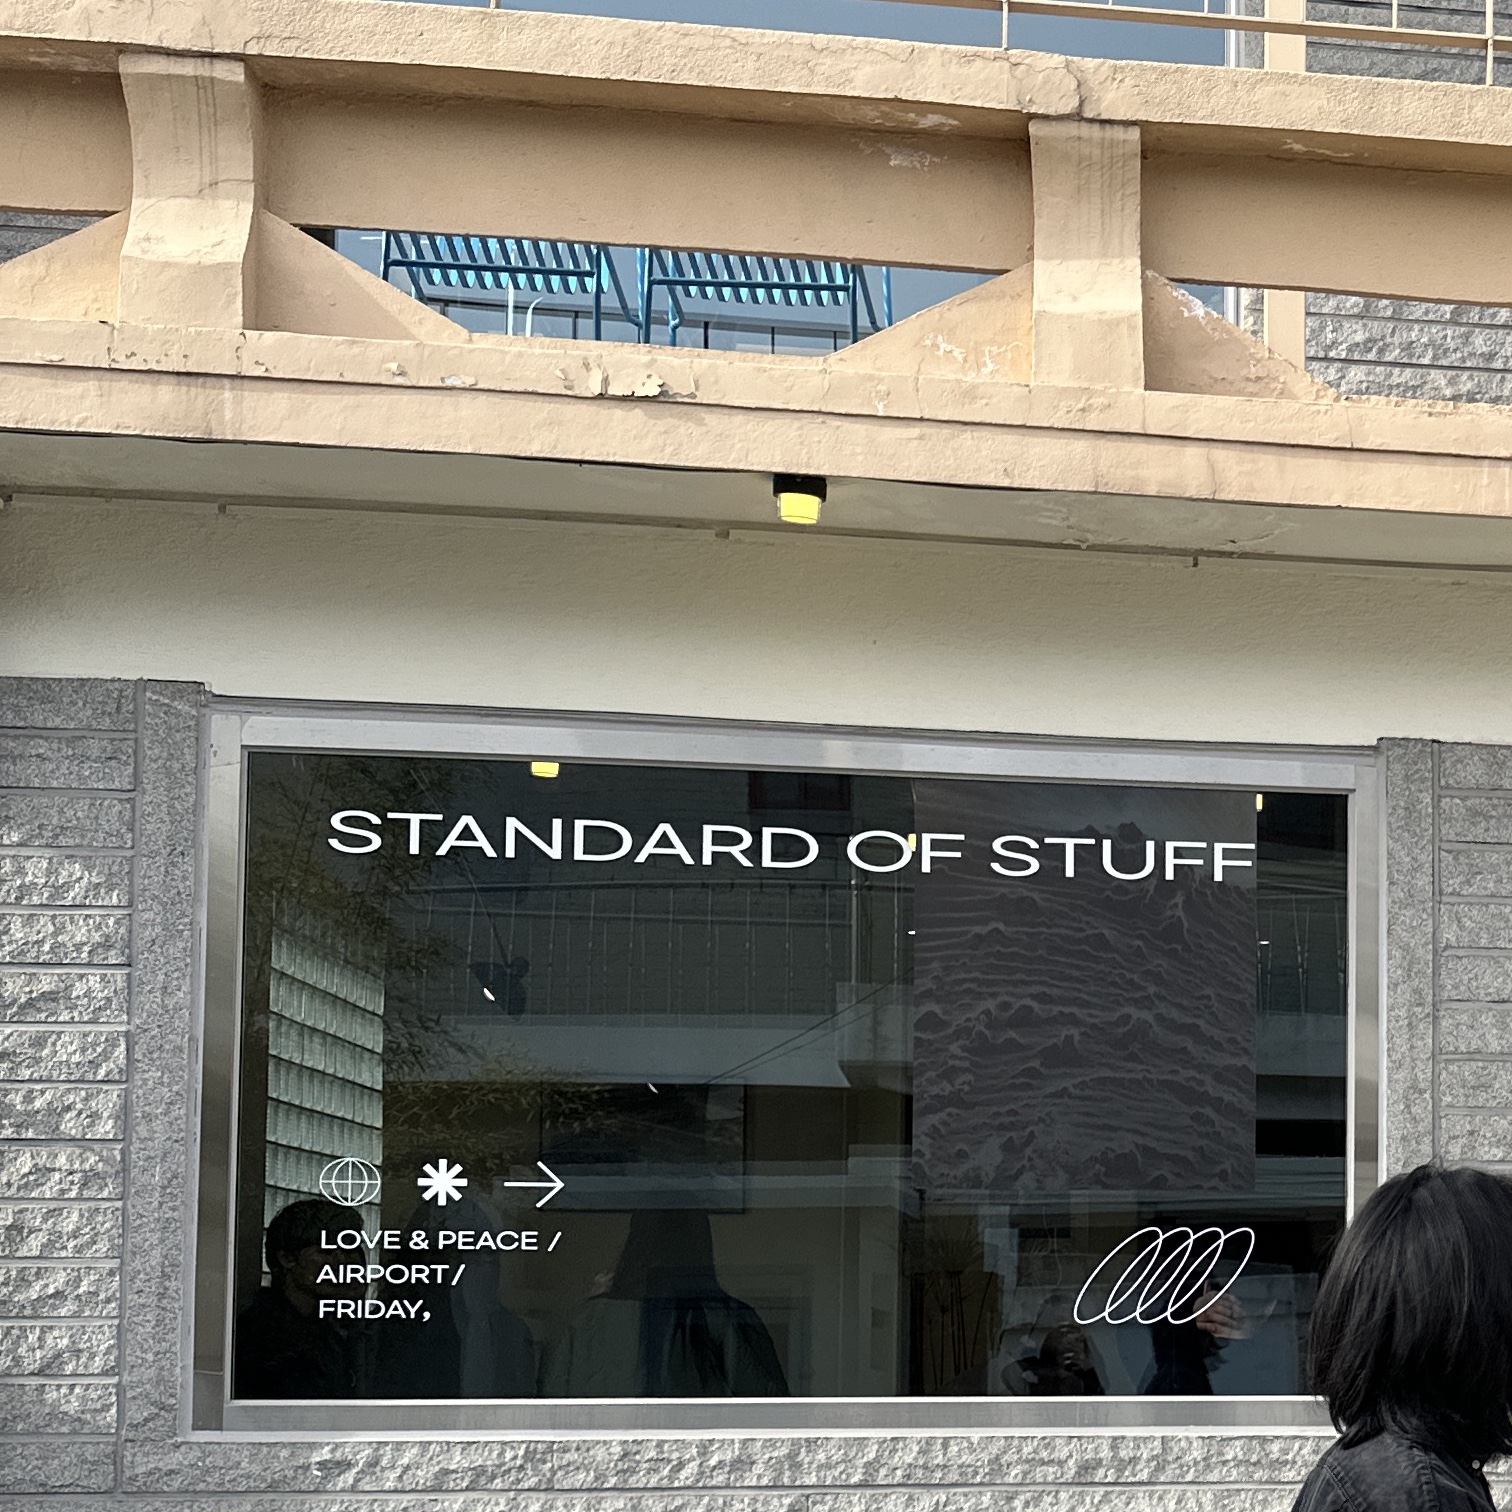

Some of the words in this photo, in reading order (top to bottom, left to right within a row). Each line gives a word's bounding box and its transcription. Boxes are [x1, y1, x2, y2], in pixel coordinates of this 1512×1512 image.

[327, 810, 819, 869] STANDARD
[846, 829, 966, 875] OF
[989, 833, 1257, 882] STUFF
[321, 1230, 401, 1250] LOVE
[409, 1230, 430, 1250] &
[439, 1230, 539, 1250] PEACE
[319, 1299, 431, 1322] FRIDAY,
